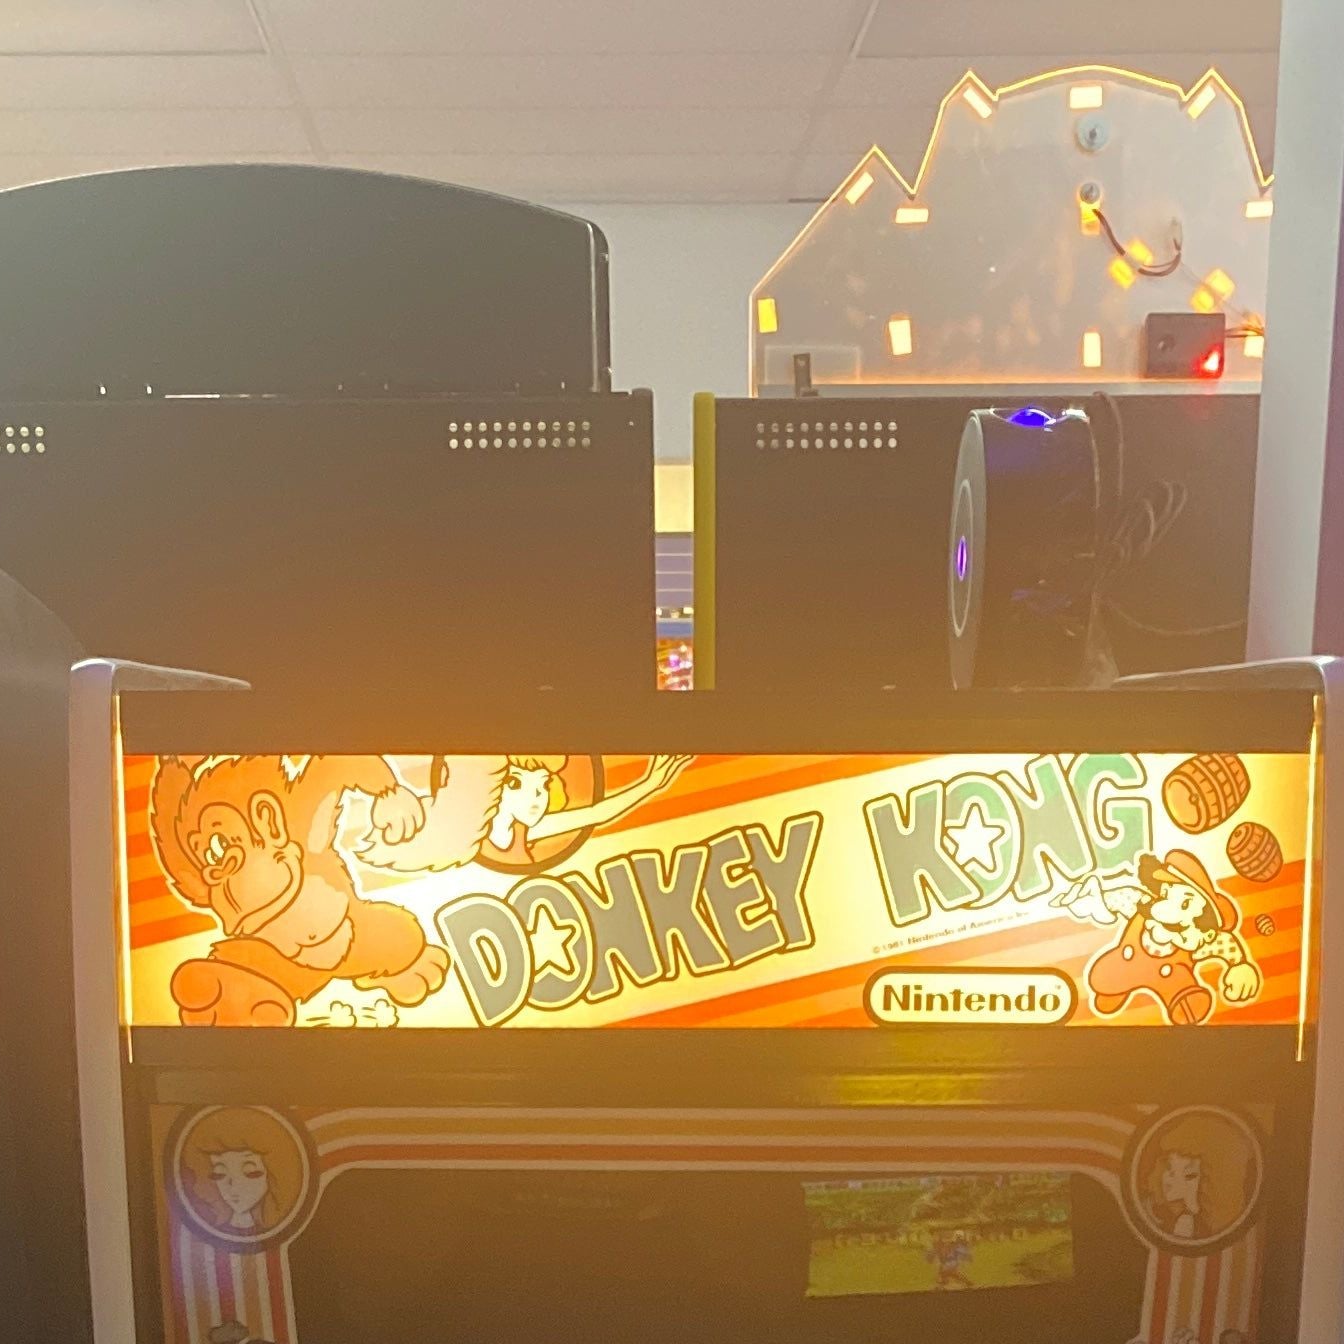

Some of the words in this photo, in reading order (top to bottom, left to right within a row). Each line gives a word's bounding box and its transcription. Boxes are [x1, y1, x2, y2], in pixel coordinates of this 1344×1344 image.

[433, 811, 824, 1028] DONKEY
[862, 753, 1154, 927] KONG
[882, 984, 1062, 1013] Nintendo
